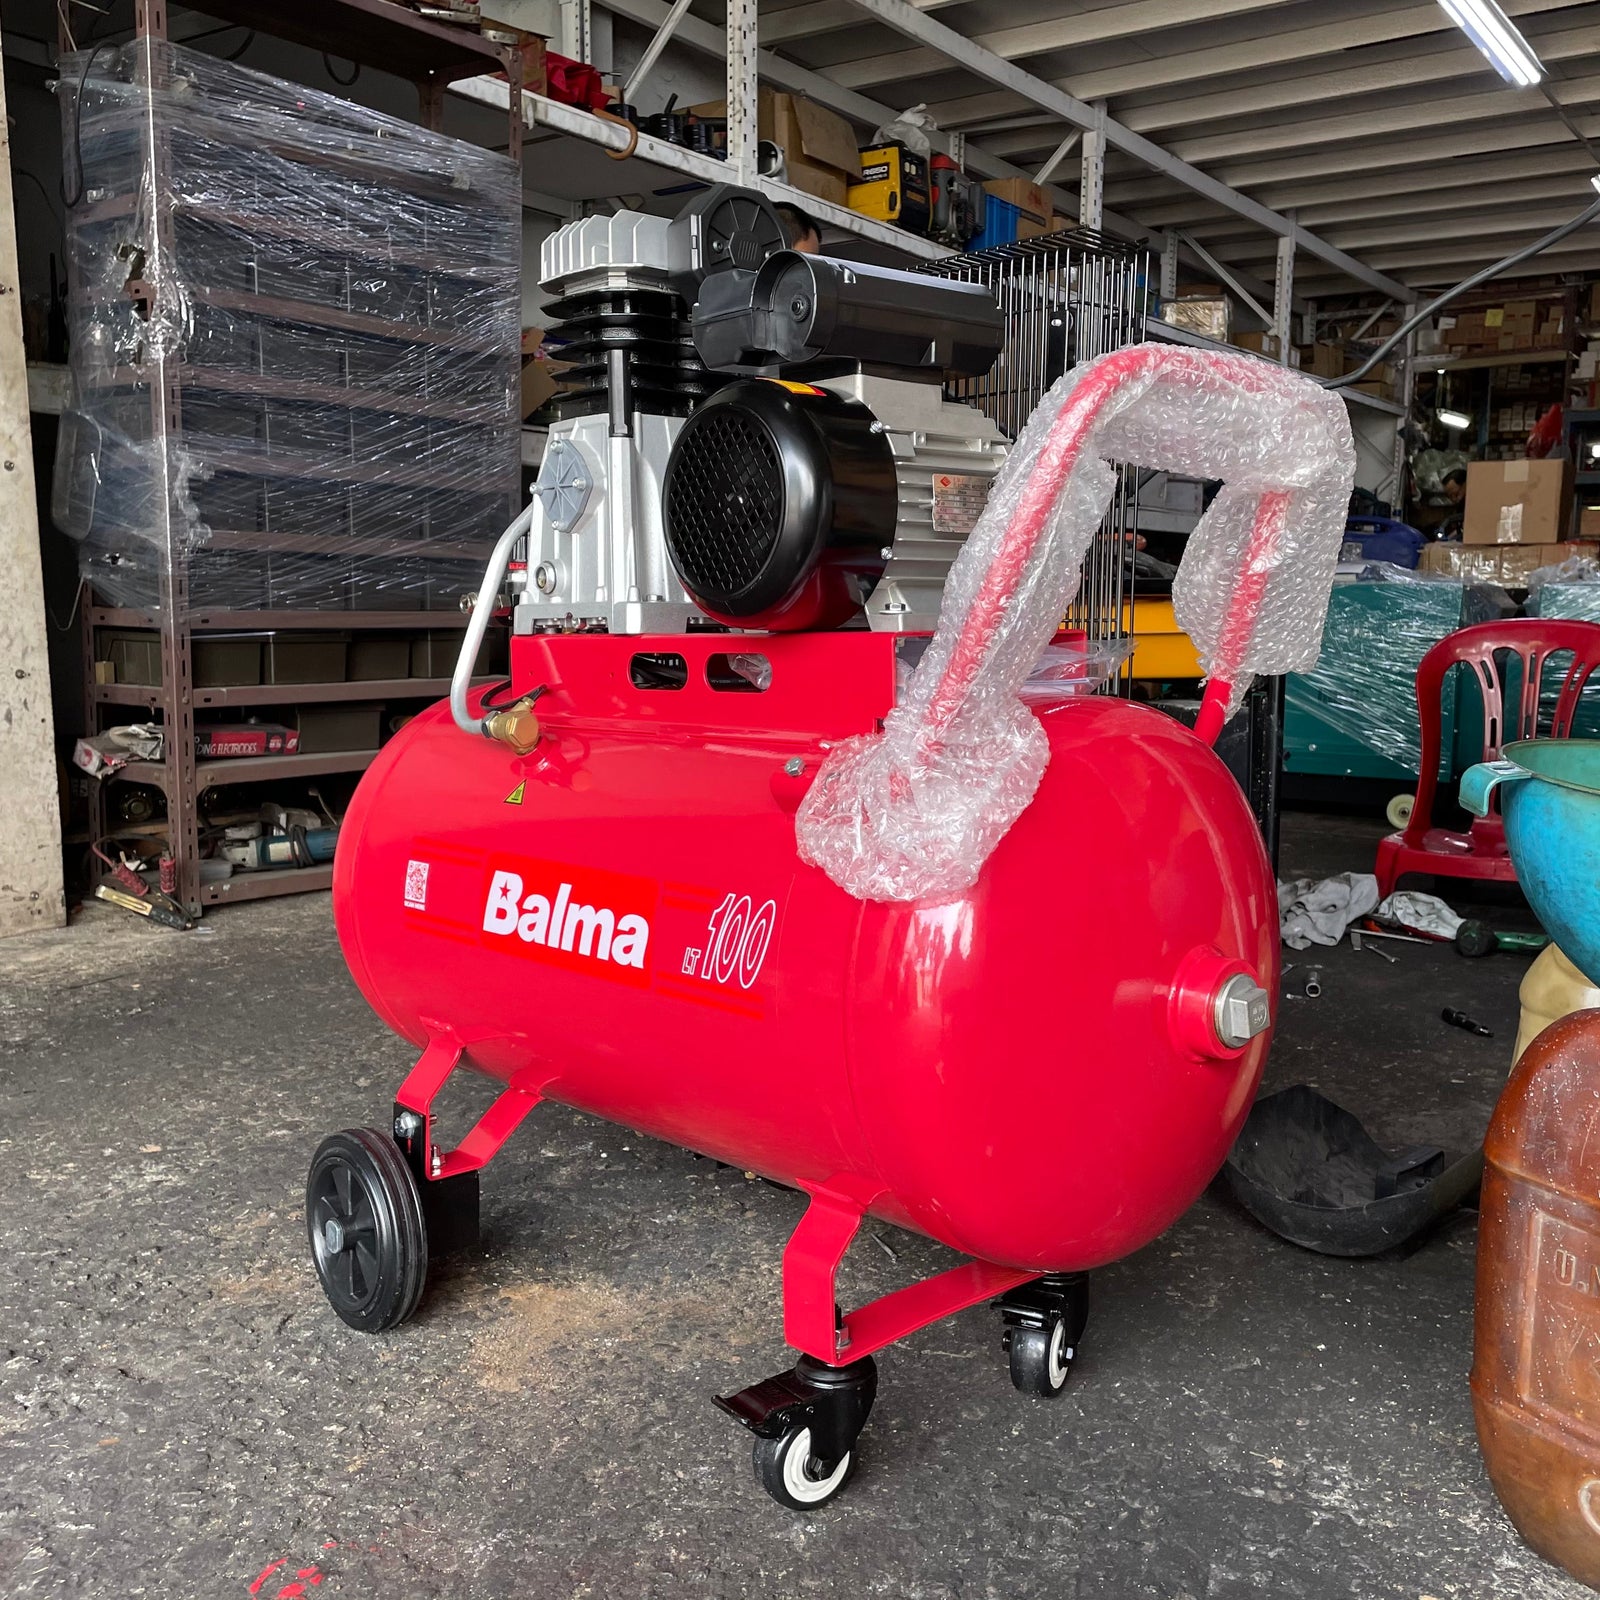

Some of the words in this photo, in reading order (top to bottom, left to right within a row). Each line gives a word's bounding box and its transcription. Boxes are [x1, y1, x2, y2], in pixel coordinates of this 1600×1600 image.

[217, 742, 257, 755] ELECTRODES
[482, 869, 650, 969] Balma
[681, 946, 701, 975] LT
[701, 892, 777, 990] 100
